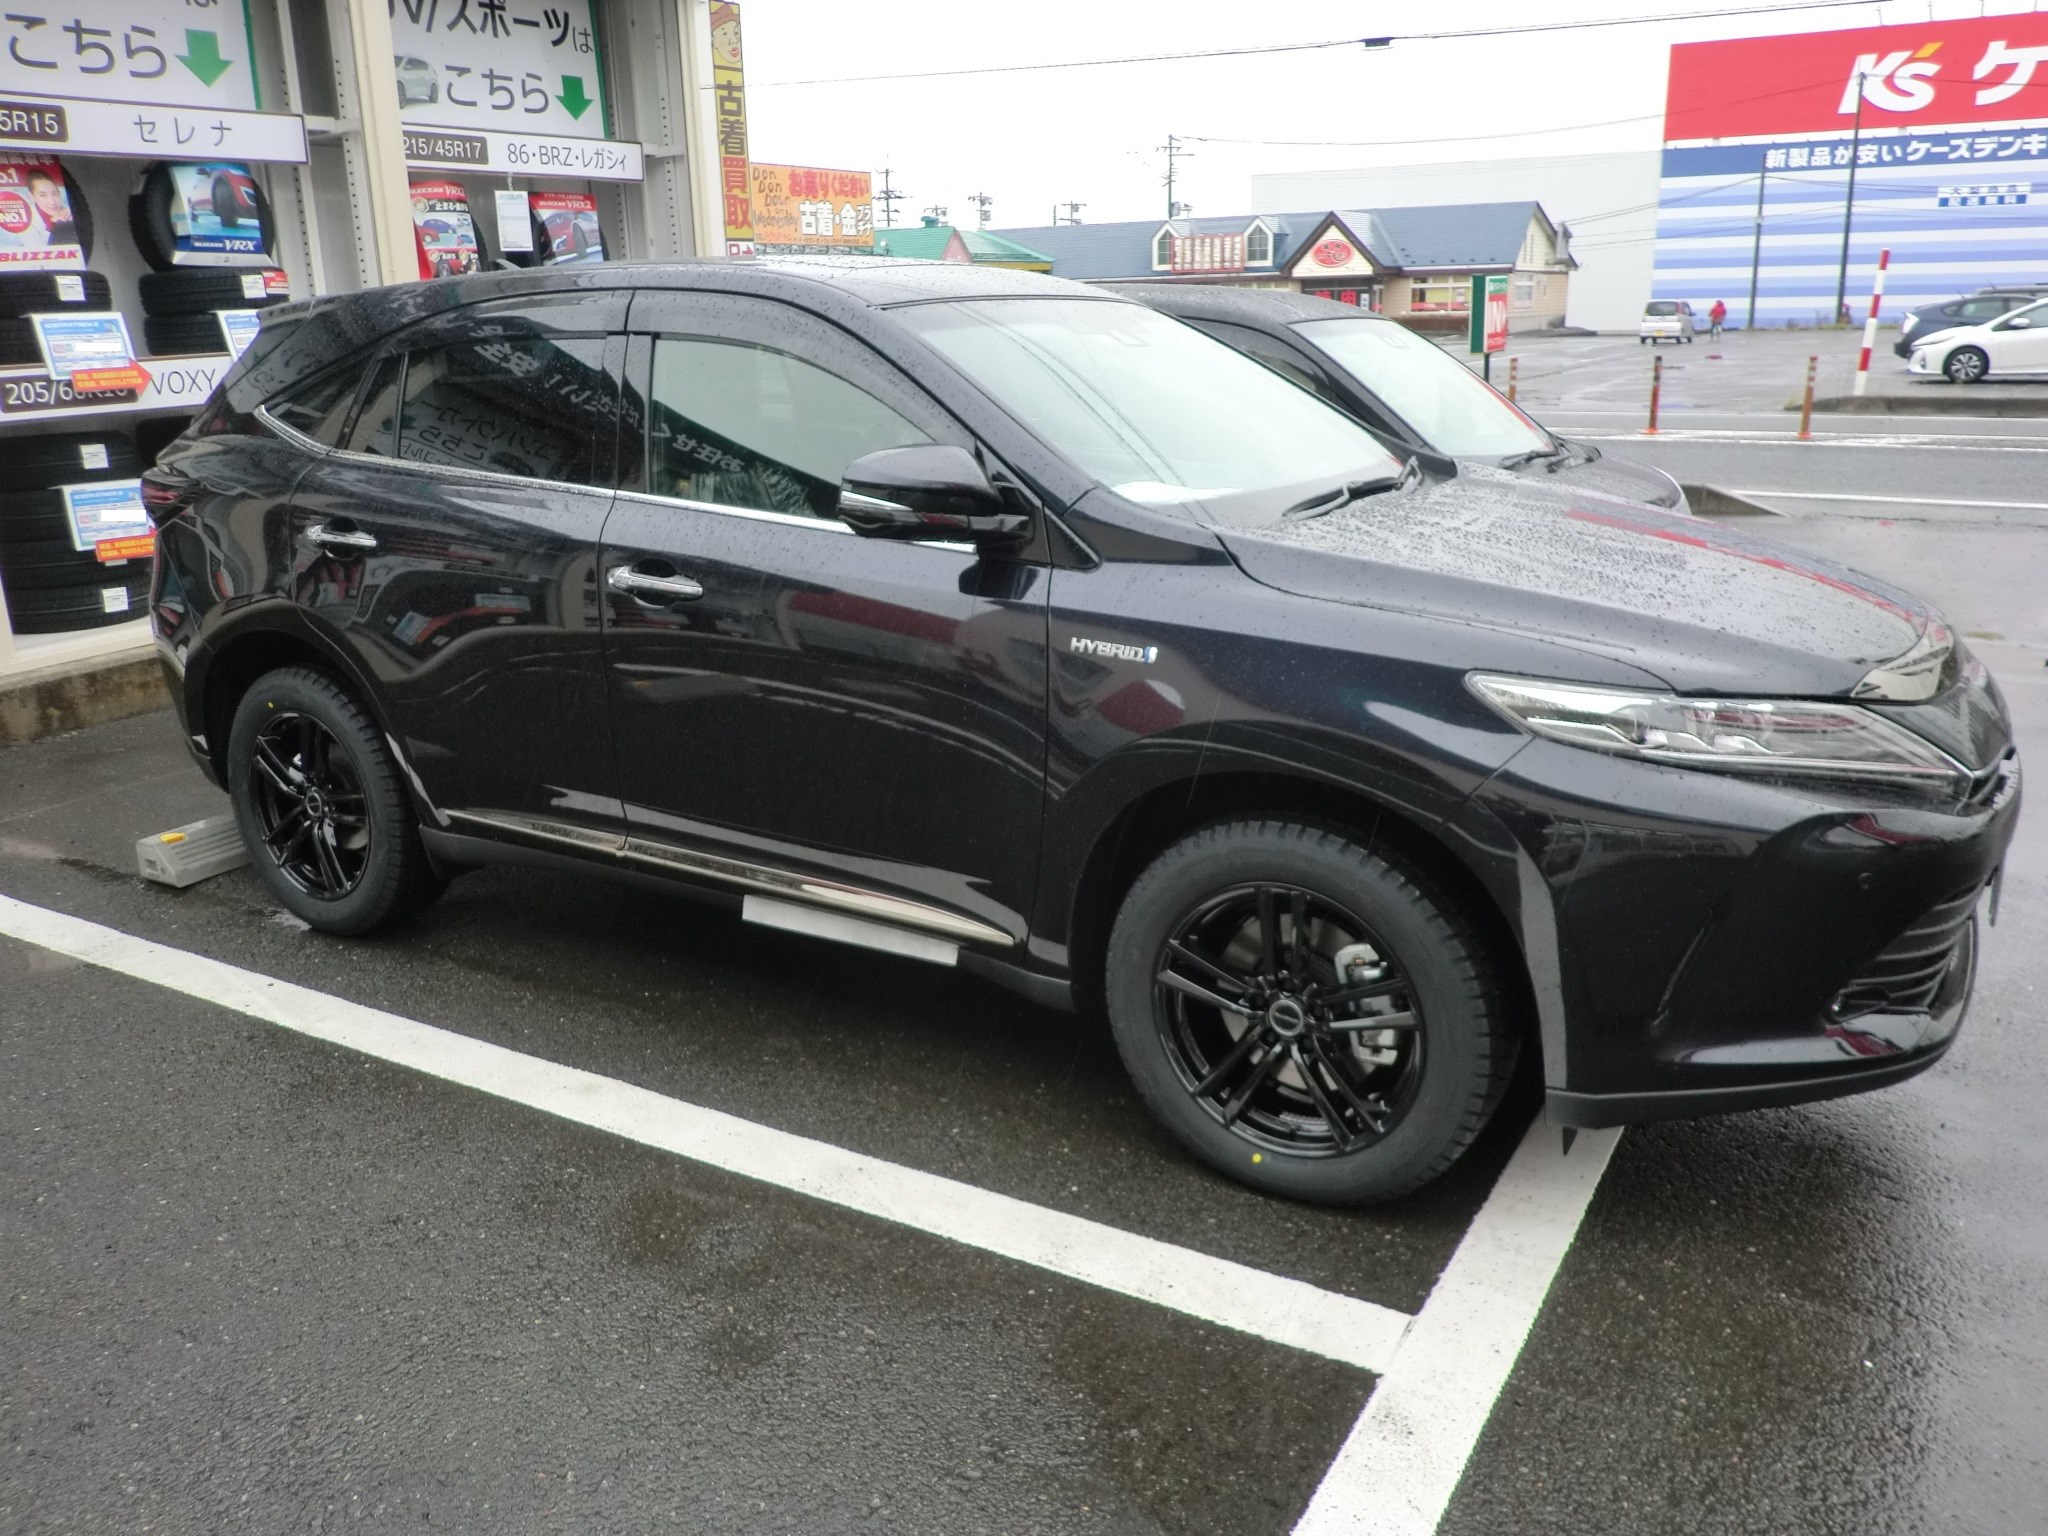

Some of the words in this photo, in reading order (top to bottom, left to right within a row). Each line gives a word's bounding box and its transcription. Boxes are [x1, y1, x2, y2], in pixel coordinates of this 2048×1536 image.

[6, 13, 167, 79] こちら
[445, 65, 549, 114] こちら
[133, 114, 232, 146] セレナ
[403, 137, 482, 159] 215/45R17
[716, 80, 752, 229] 古着買取
[151, 368, 216, 395] VOXY
[1070, 636, 1144, 662] HYBRID
